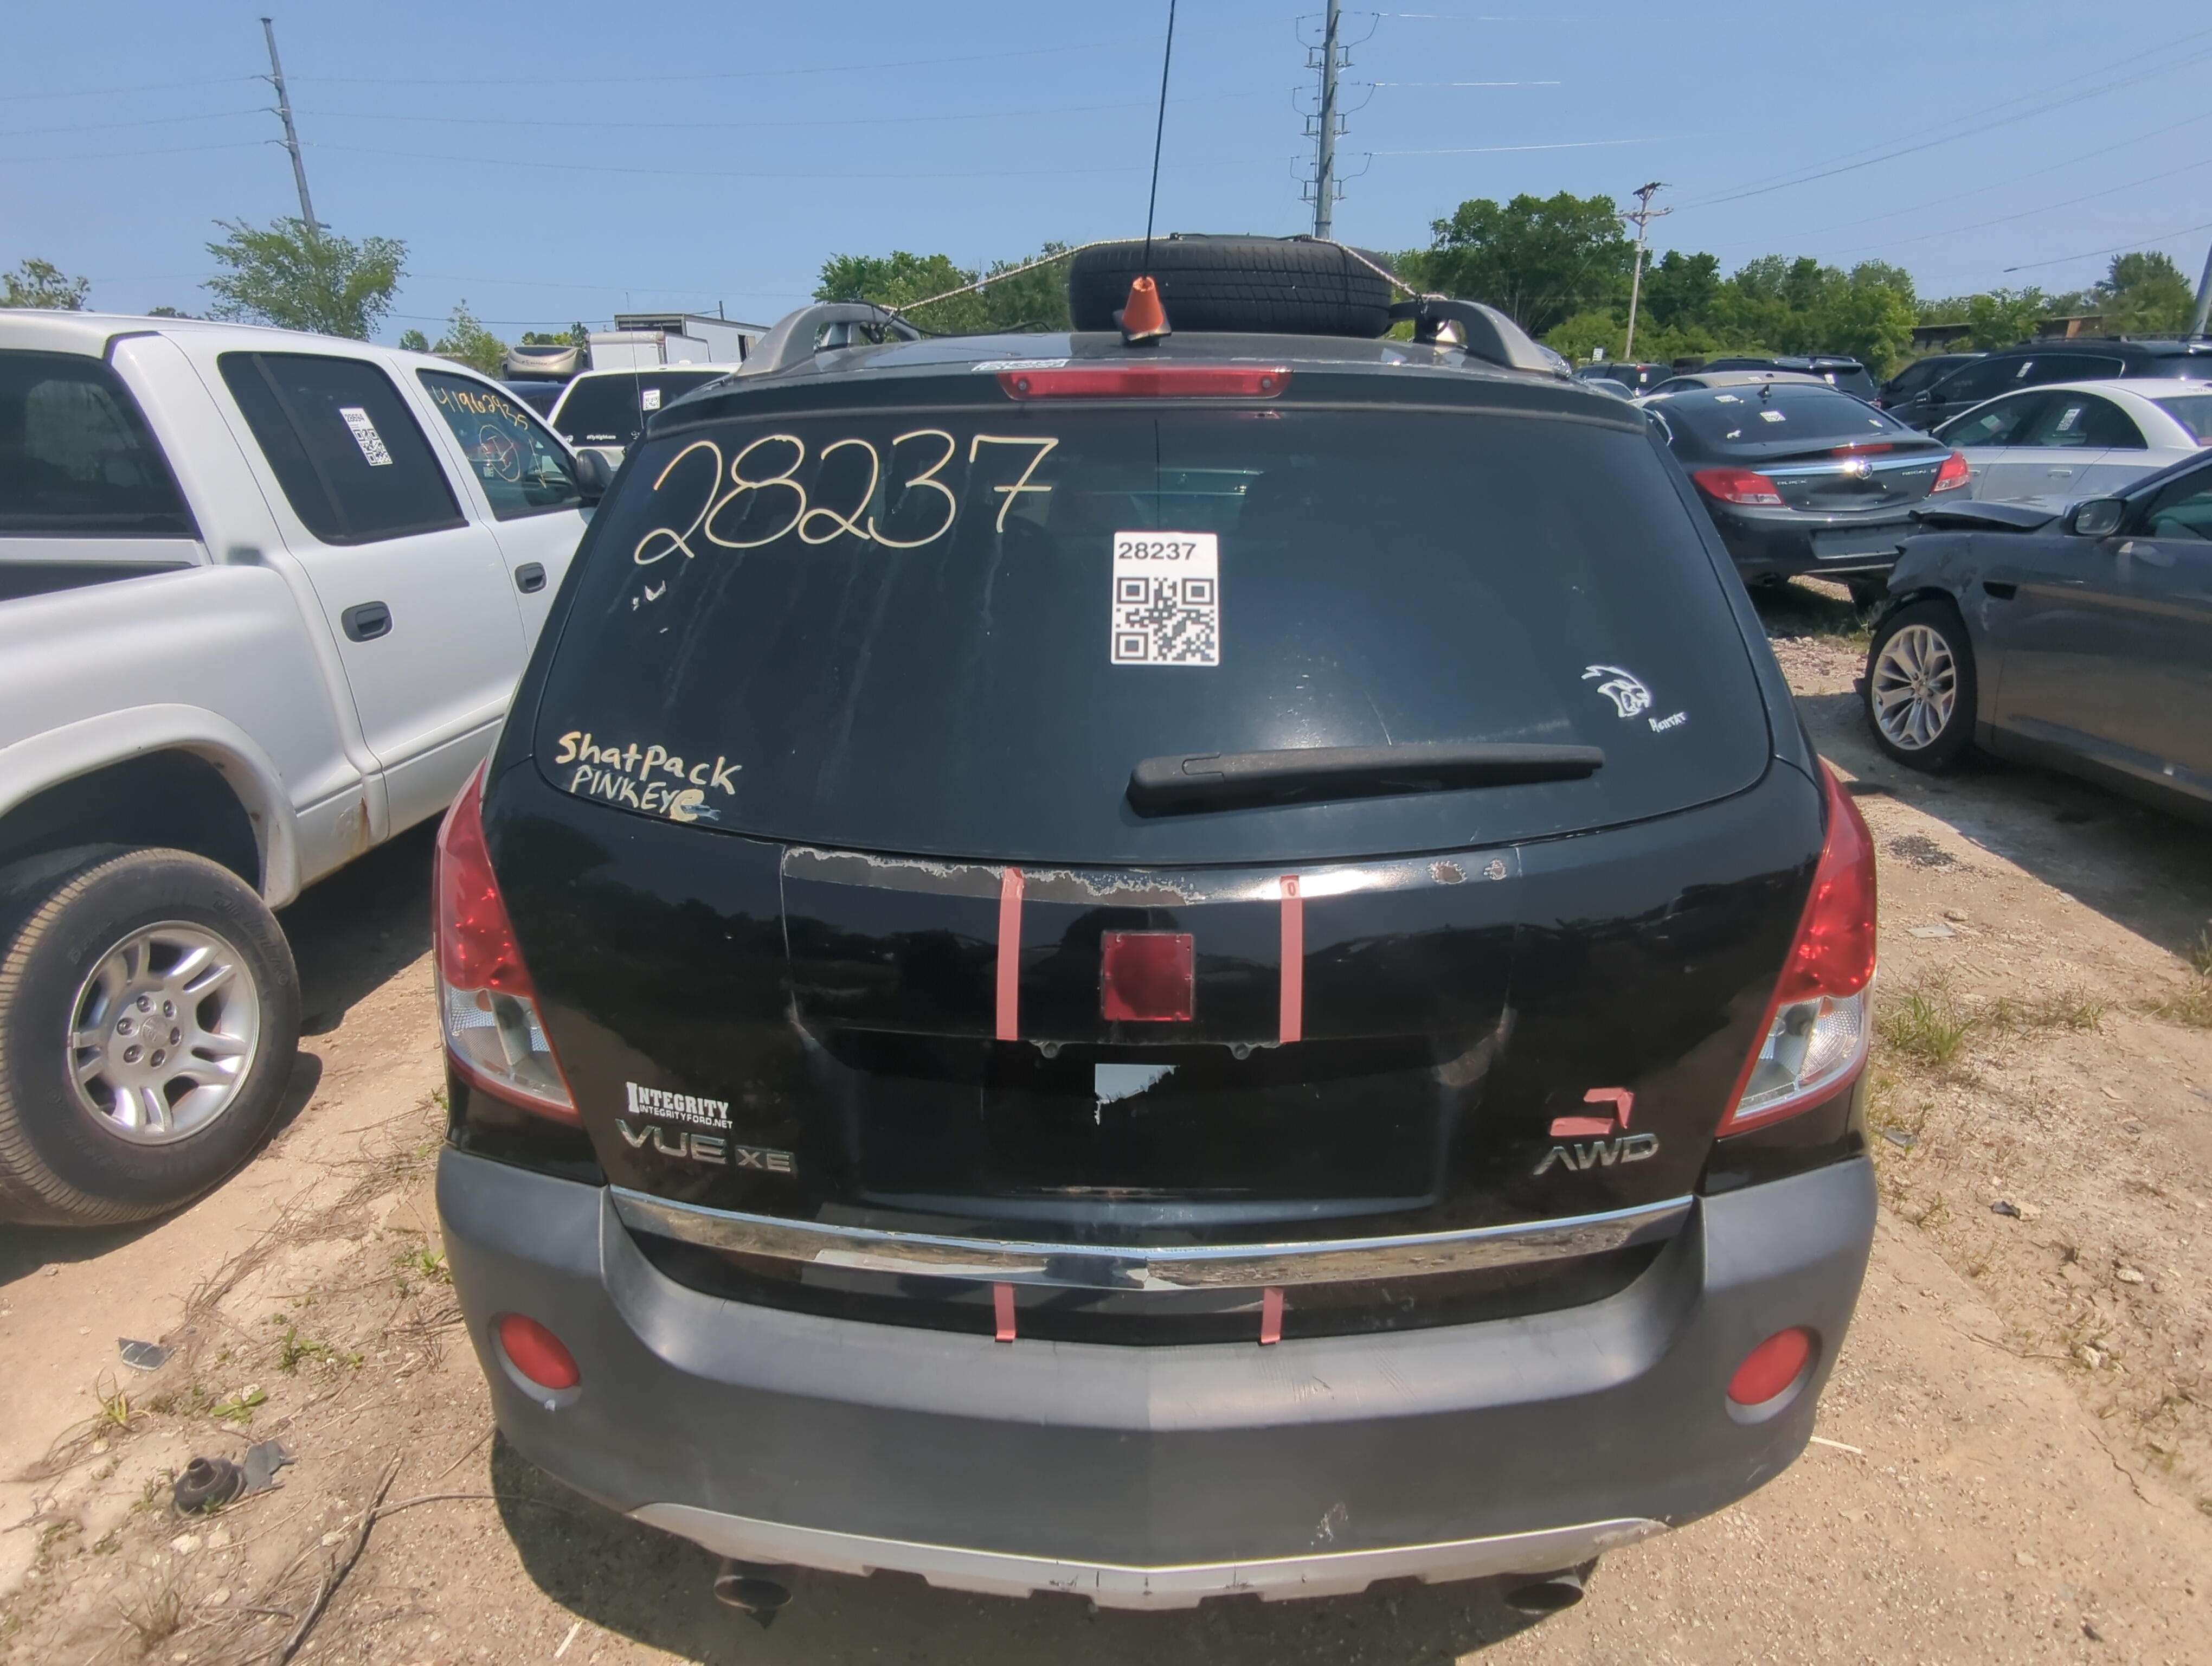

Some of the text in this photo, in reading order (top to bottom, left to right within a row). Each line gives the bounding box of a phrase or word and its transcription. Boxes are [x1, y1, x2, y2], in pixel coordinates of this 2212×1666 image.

[634, 429, 1059, 565] 28237
[1118, 542, 1196, 561] 28237
[626, 1081, 729, 1119] INTEGRITY
[639, 1104, 734, 1130] INTEGRITYFORD.NET
[615, 1118, 791, 1172] VUE XE
[1532, 1133, 1660, 1176] AWD
